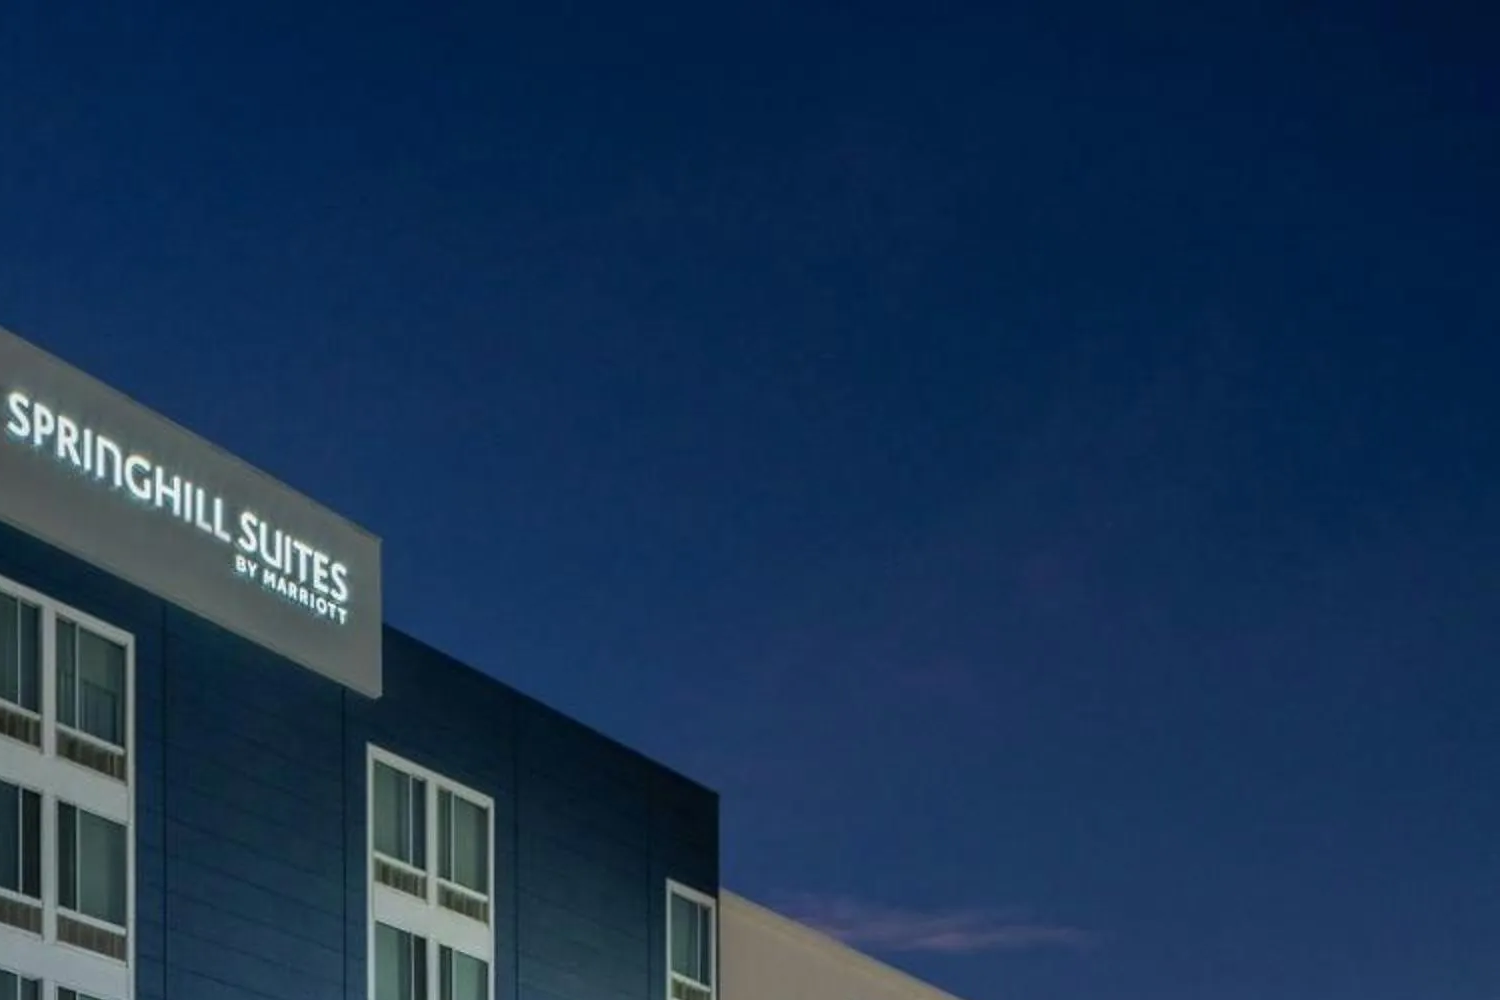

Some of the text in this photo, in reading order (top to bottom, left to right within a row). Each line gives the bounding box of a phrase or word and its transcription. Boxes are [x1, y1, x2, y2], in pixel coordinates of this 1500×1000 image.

[6, 391, 349, 603] SPRINGHILL SUITES
[235, 555, 348, 624] BY MARRIOTT
